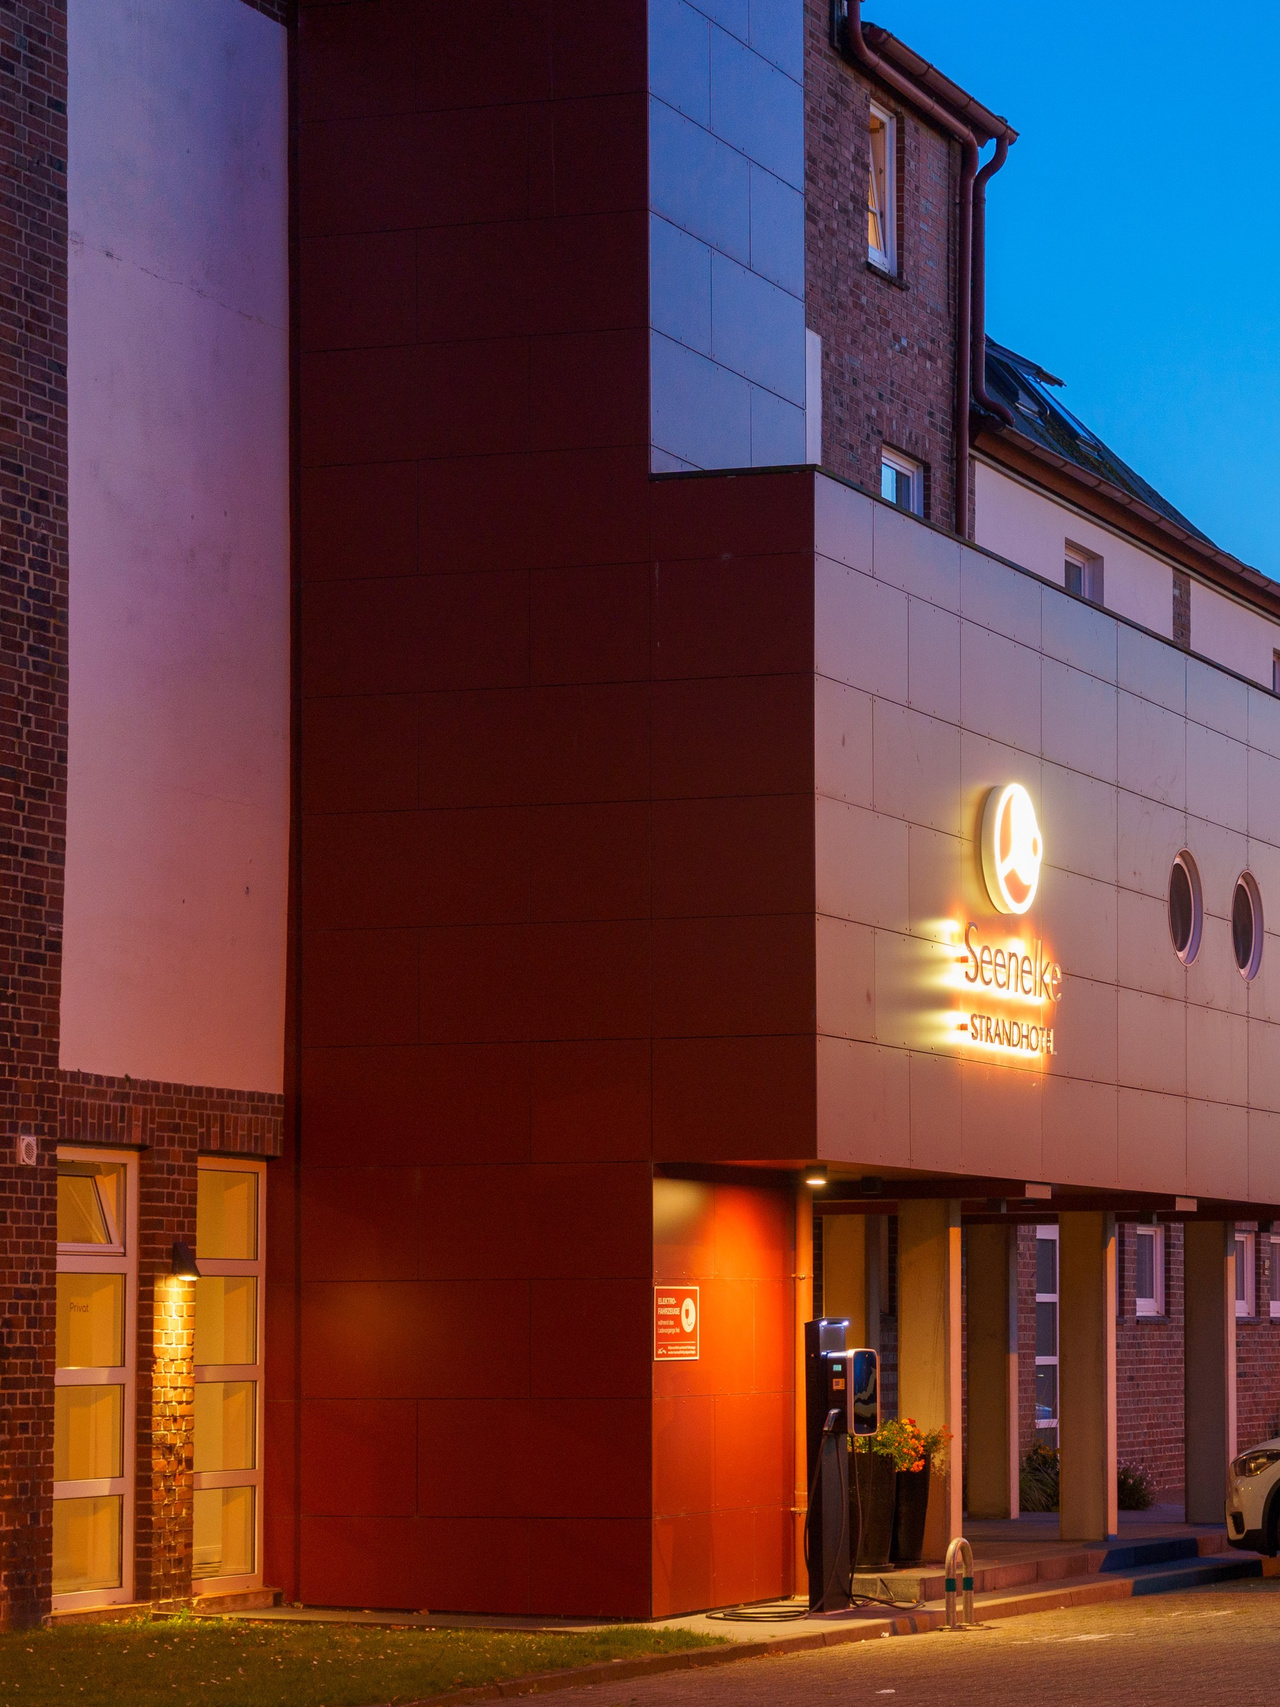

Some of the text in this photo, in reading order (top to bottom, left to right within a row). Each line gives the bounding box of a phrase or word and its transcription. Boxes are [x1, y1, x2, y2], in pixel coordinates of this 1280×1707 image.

[964, 921, 1063, 1003] Seenelke
[970, 1013, 1057, 1055] STRANDHOTEL
[69, 1302, 90, 1313] Privat
